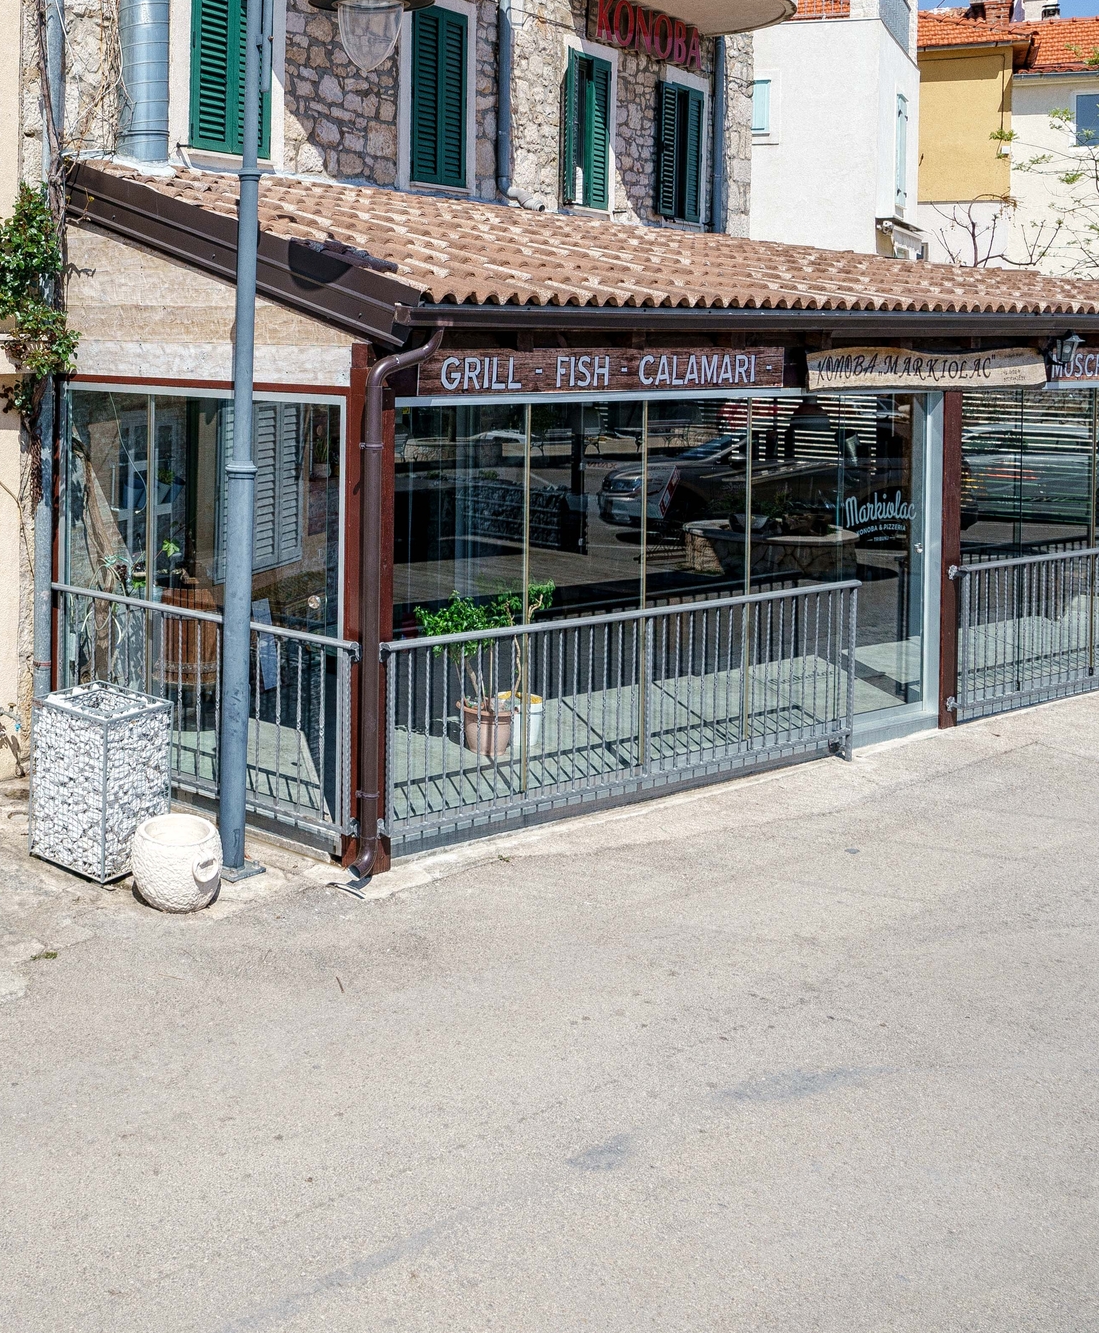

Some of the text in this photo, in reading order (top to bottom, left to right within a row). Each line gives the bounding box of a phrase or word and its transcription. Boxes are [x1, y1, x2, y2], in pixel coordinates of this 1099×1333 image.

[440, 356, 522, 391] GRILL
[556, 355, 610, 388] FISH
[638, 354, 757, 386] CALAMARI
[816, 353, 878, 387] KONOBA
[845, 489, 917, 528] Markiolac
[856, 525, 879, 537] KONOBA
[883, 523, 906, 531] PIZZERIA
